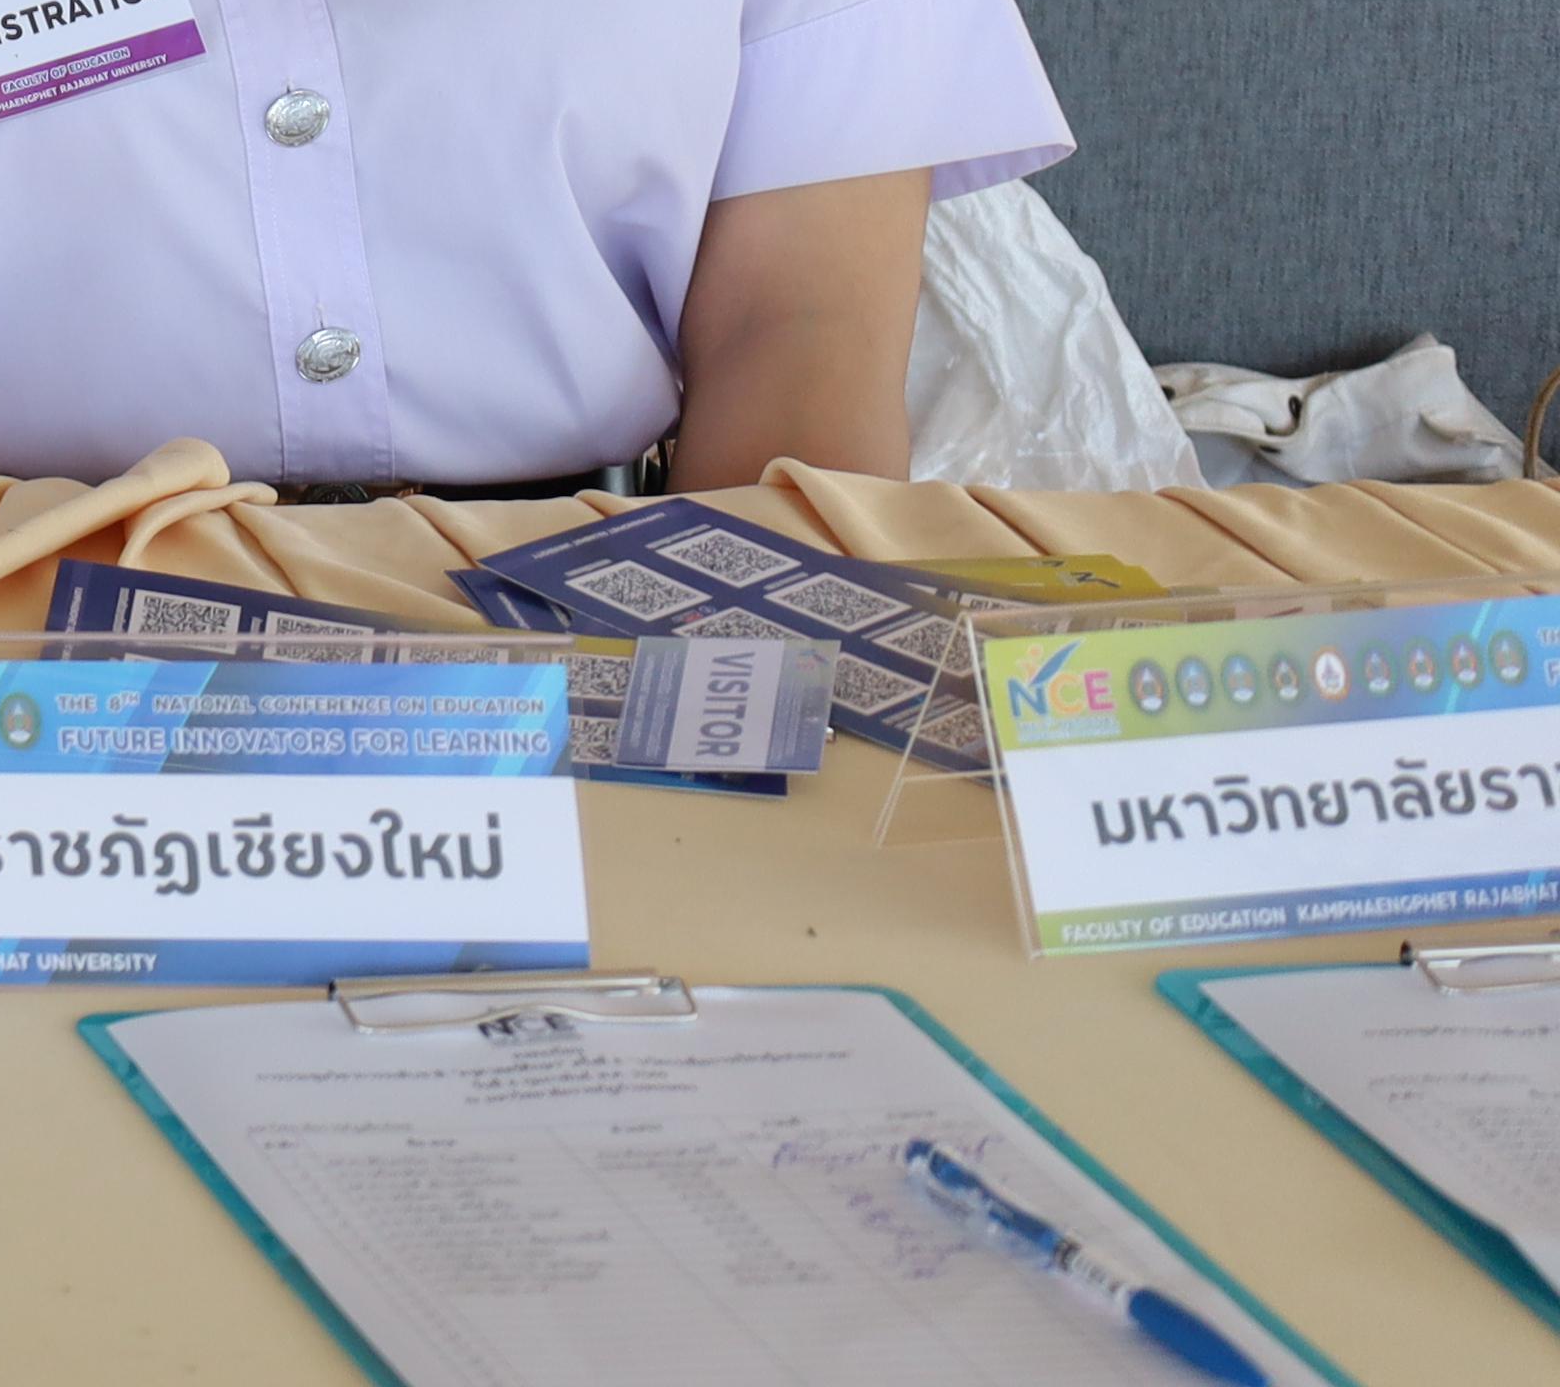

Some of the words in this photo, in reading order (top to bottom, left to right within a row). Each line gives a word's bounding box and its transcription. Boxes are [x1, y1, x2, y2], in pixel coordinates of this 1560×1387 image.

[1, 71, 49, 94] FACULTY
[51, 66, 67, 79] OF
[68, 47, 131, 74] EDUCATION
[60, 71, 109, 94] RAJABHAT
[111, 54, 167, 78] UNIVERSITY
[56, 693, 97, 713] THE
[153, 693, 256, 715] NATIONAL
[259, 694, 391, 716] CONFERENCE
[396, 695, 426, 715] ON
[431, 696, 545, 716] EDUCATION
[695, 651, 756, 757] VISITOR
[1007, 671, 1116, 717] NCE
[60, 727, 166, 754] FUTURE
[173, 727, 346, 755] INNOVATORS
[351, 728, 408, 755] FOR
[415, 728, 550, 756] LEARNING
[1091, 757, 1560, 846] มหาวิทยาลัยรา
[1061, 919, 1142, 945] FACULTY
[1150, 917, 1176, 937] OF
[1179, 908, 1287, 935] EDUCATION
[1297, 889, 1458, 924] KAMPHAENGPHET
[1464, 881, 1559, 910] RAJABHAT
[37, 952, 157, 973] UNIVERSITY
